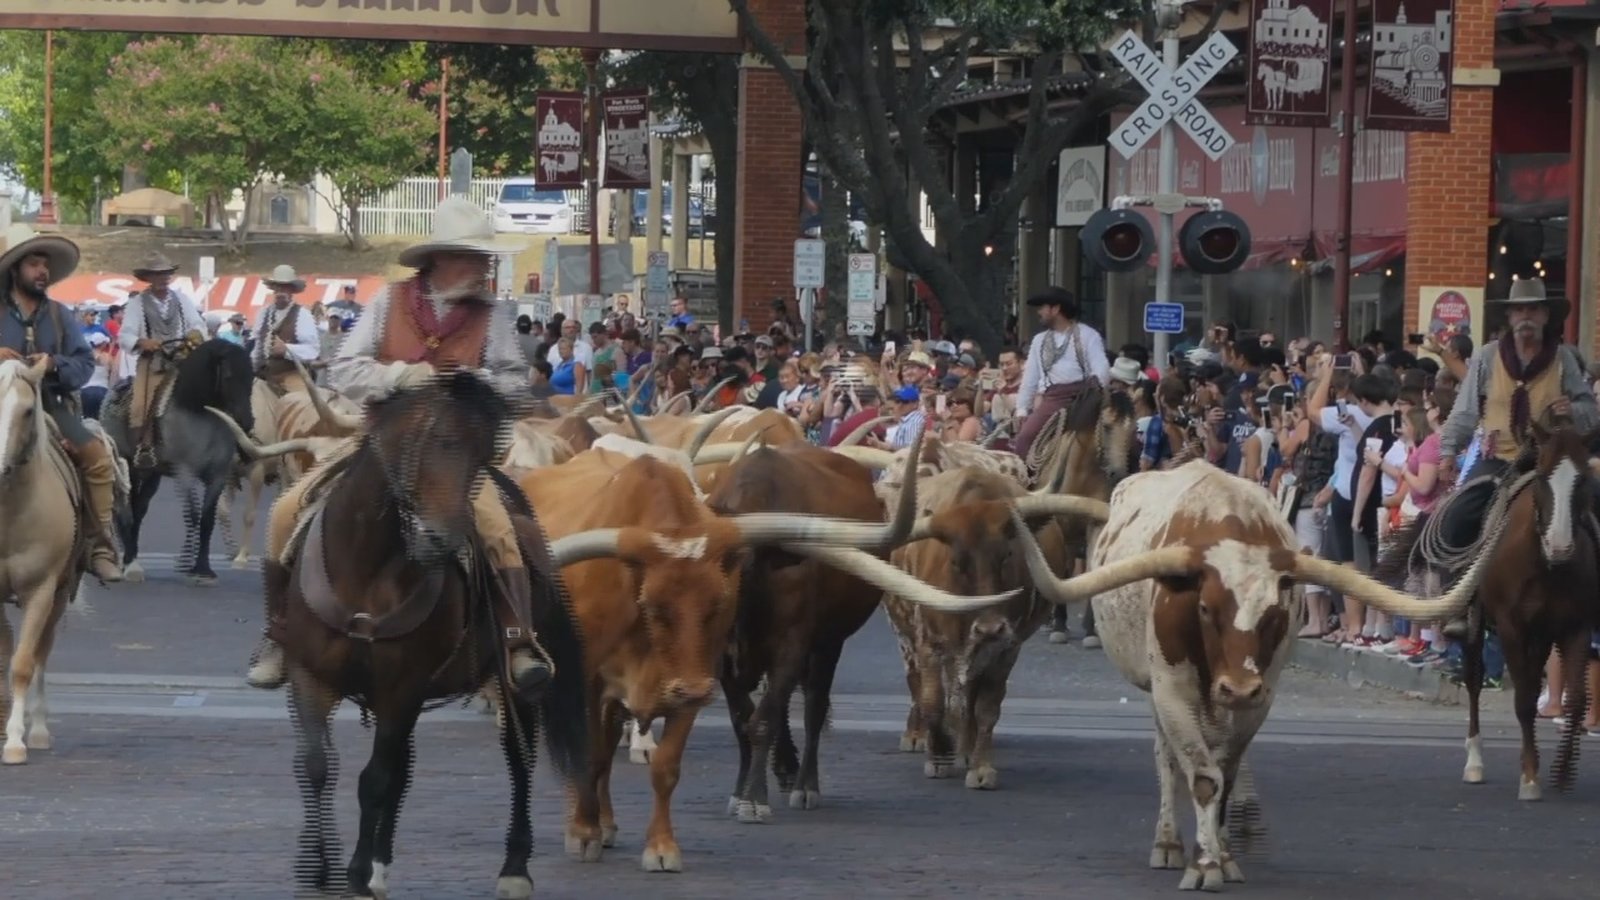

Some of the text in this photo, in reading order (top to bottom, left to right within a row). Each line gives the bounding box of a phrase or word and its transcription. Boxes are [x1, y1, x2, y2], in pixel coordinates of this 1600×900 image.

[1117, 37, 1226, 153] RAIL ROAD
[1120, 43, 1226, 147] CROSSING
